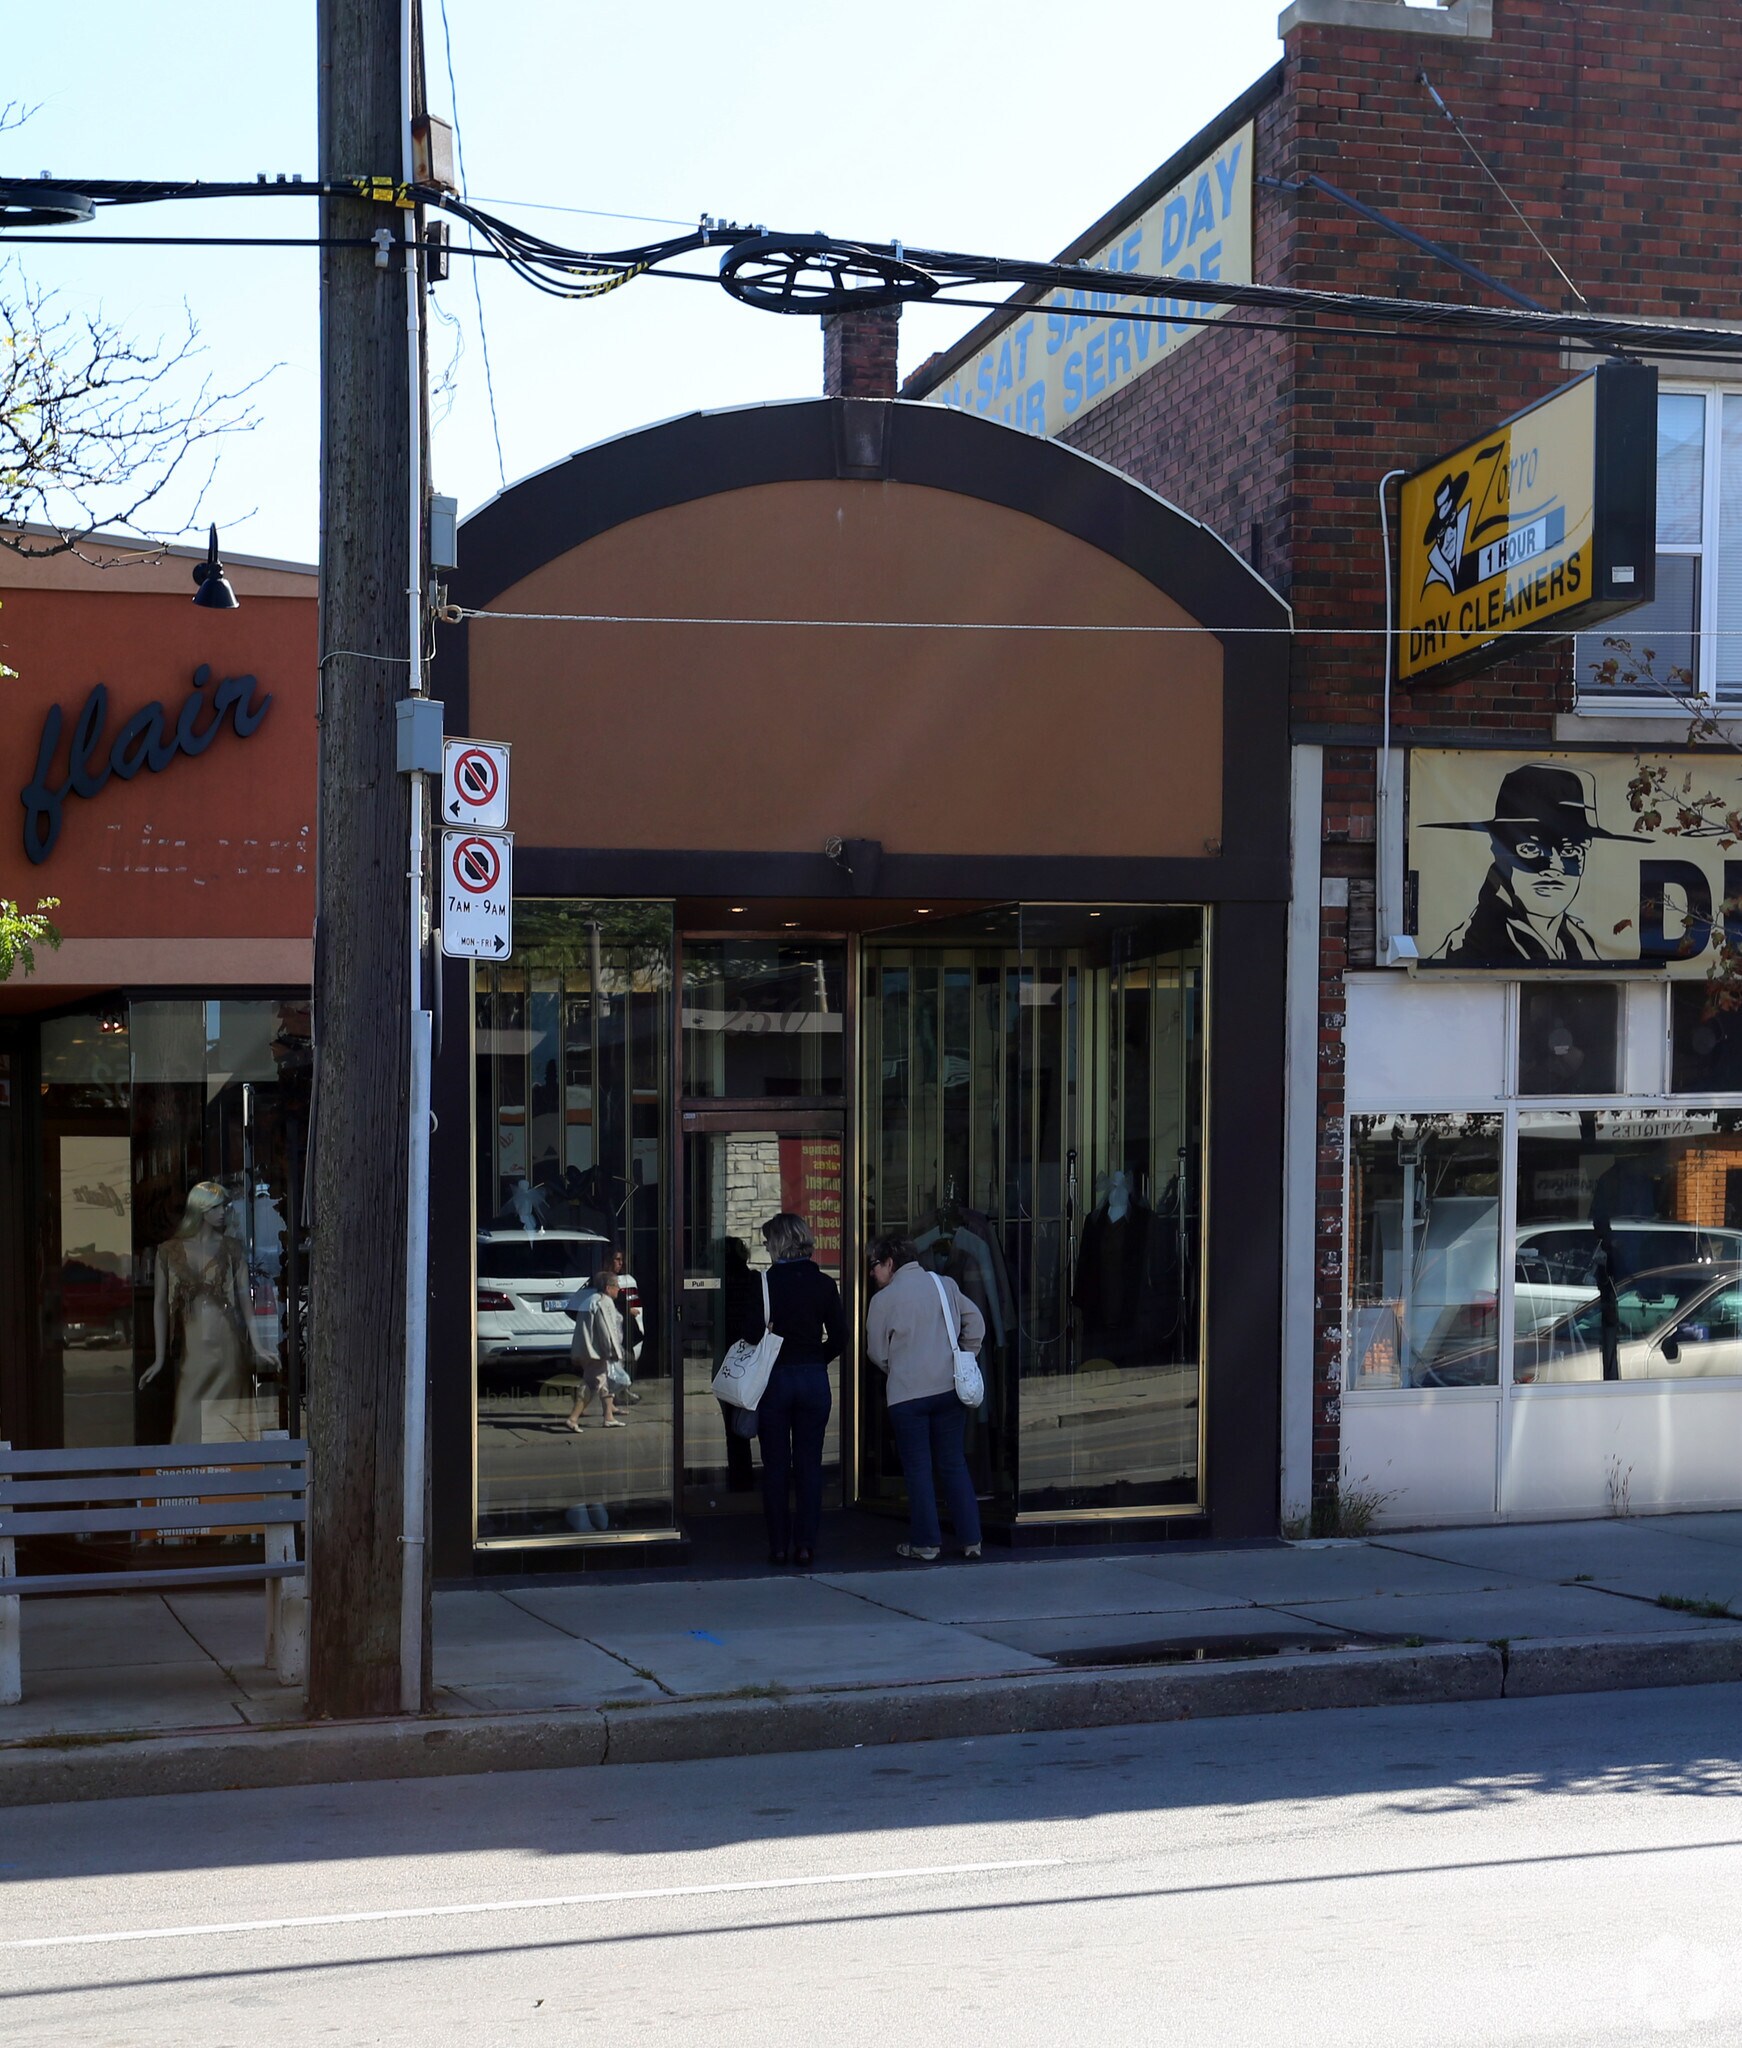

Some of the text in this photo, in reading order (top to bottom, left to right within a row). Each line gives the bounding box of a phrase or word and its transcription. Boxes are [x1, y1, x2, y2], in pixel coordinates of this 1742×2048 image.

[1161, 152, 1244, 279] DAY
[1063, 240, 1224, 416] SERVICE
[1471, 440, 1549, 542] Zorro
[1486, 527, 1537, 574] 1 HOUR
[1411, 551, 1582, 664] DRY CLEANERS
[20, 662, 273, 866] flair
[448, 896, 471, 913] 7AM
[483, 899, 506, 916] 9AM
[1640, 860, 1742, 963] D
[691, 1280, 705, 1288] Pull
